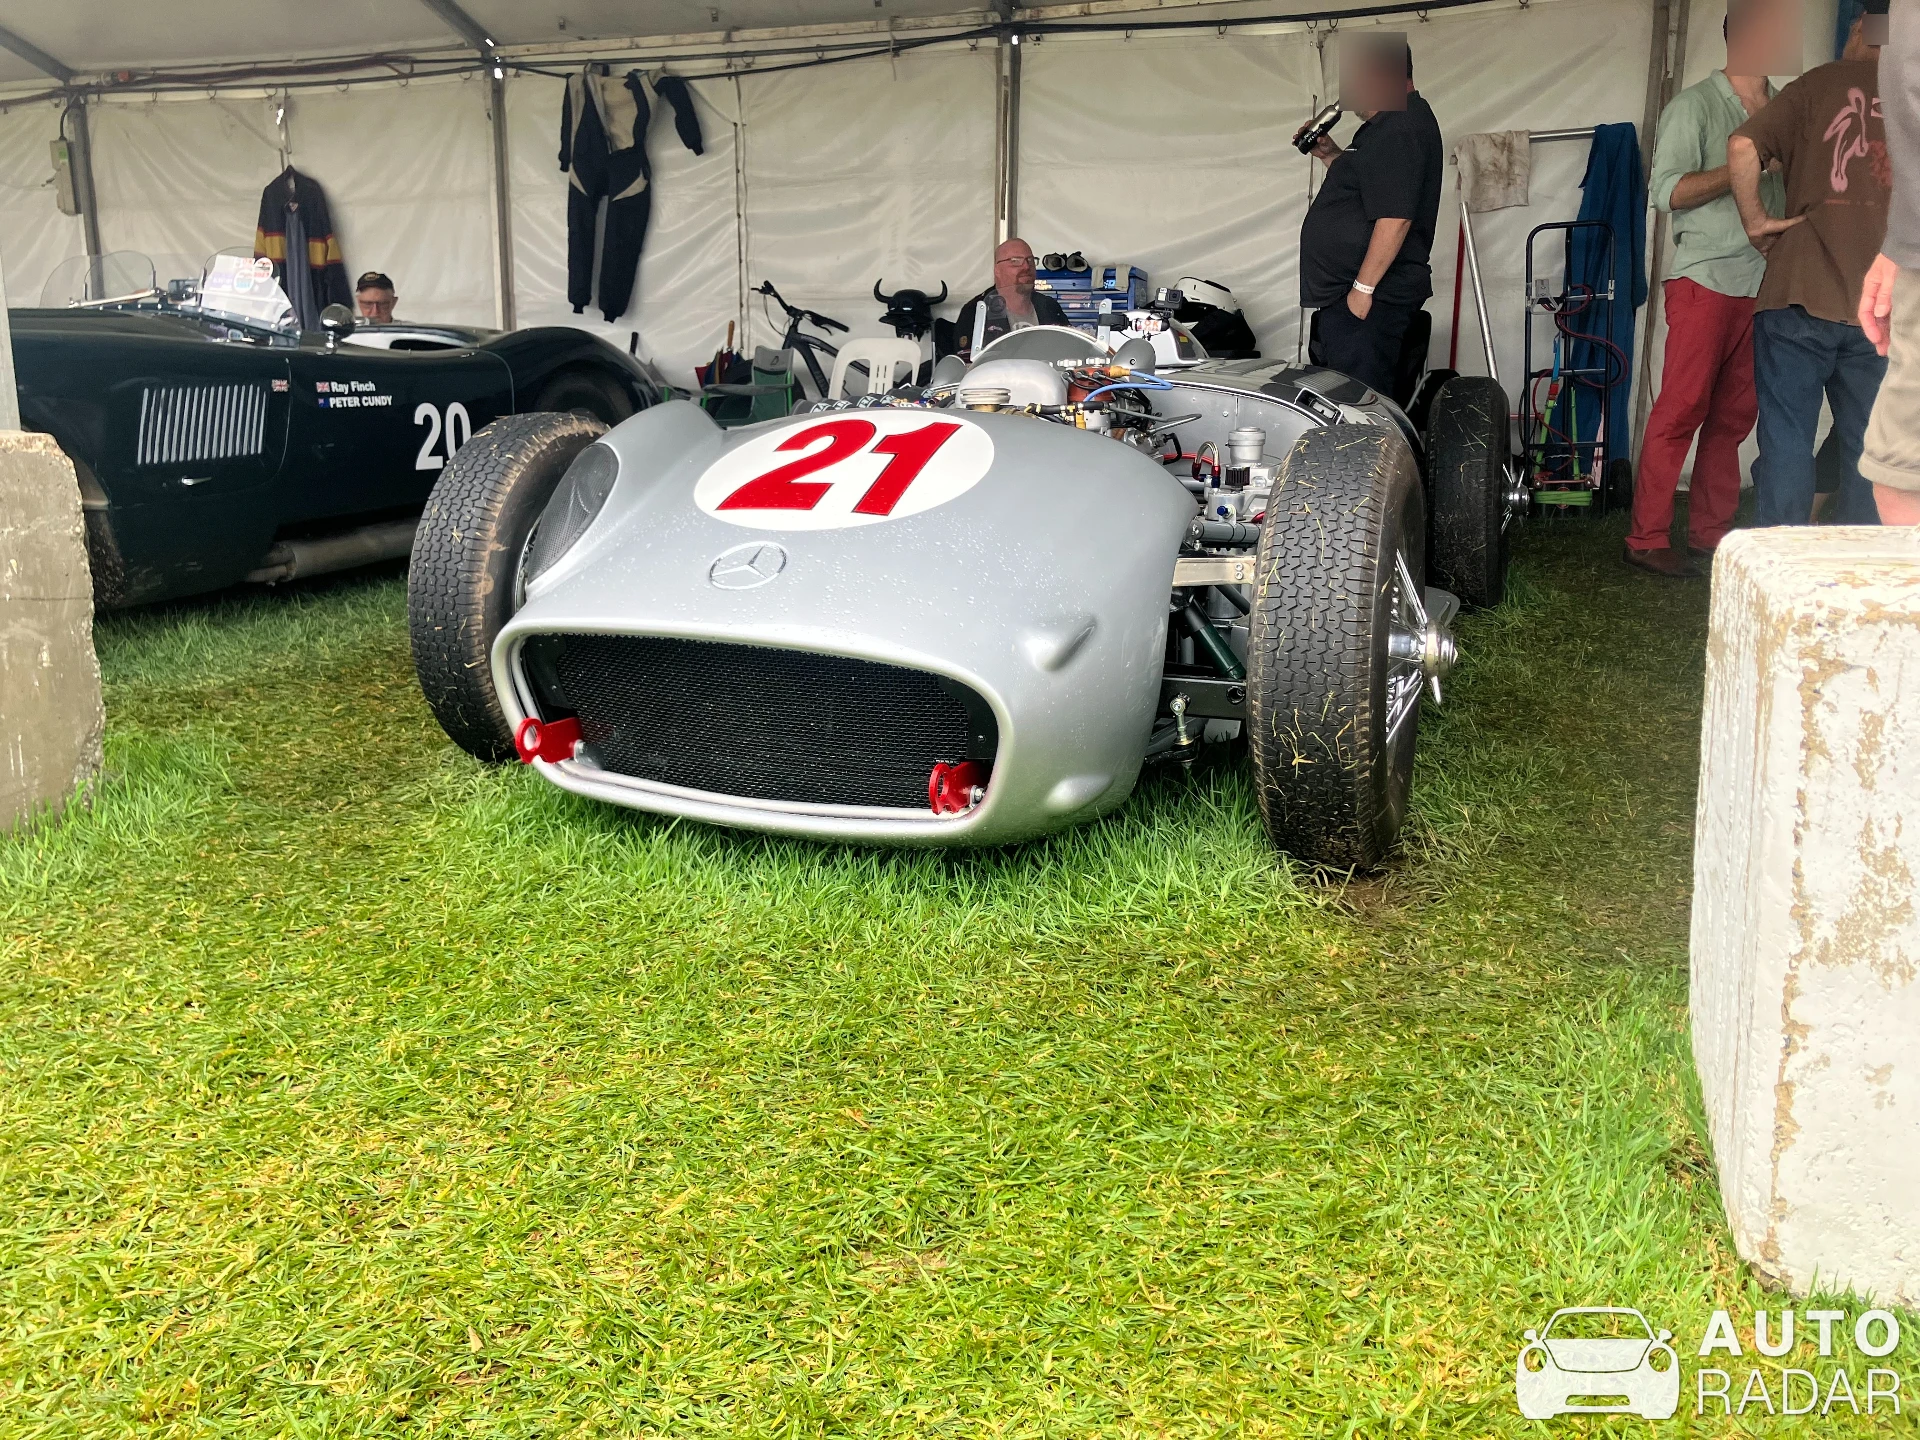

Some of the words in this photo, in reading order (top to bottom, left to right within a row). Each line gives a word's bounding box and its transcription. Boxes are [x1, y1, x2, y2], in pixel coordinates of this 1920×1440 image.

[329, 396, 361, 408] PETER
[361, 395, 392, 407] CUNDY
[330, 381, 349, 395] Ray
[350, 380, 376, 392] Finch
[414, 401, 472, 471] 20
[715, 419, 963, 516] 21
